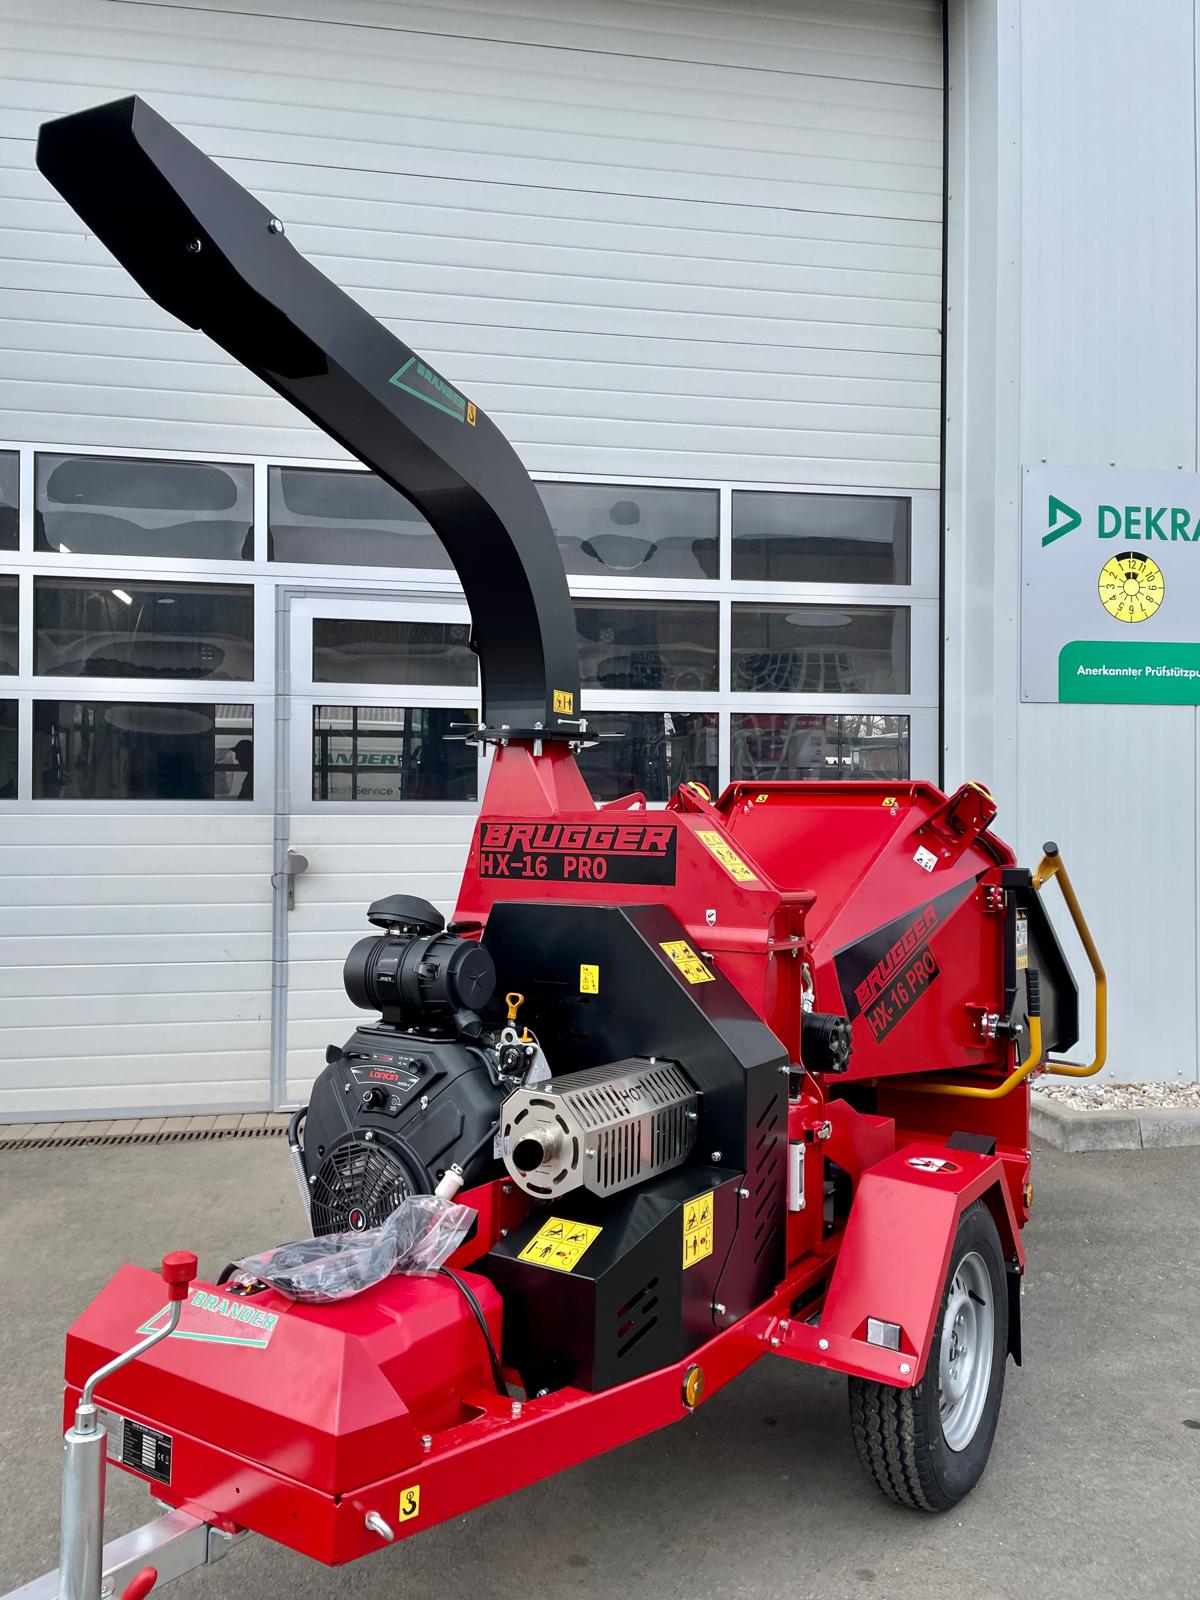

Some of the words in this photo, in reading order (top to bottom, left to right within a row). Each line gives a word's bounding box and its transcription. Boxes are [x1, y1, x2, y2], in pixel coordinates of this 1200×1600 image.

[1098, 505, 1200, 541] DEKR
[1127, 559, 1137, 570] 12
[1138, 562, 1147, 573] 11
[1108, 571, 1118, 579] 2
[1145, 571, 1156, 582] 10
[1145, 595, 1154, 603] 8
[1117, 602, 1125, 611] 5
[1128, 604, 1135, 615] 6
[1139, 602, 1146, 612] 7
[1076, 664, 1143, 676] Anerkannter
[482, 824, 675, 852] BRUGGER
[480, 853, 548, 878] HX-16
[563, 856, 608, 880] PRO
[854, 903, 938, 1007] BRUGGER
[867, 982, 910, 1038] HX-16
[905, 950, 937, 994] PRO
[619, 1085, 647, 1103] HOT
[191, 1291, 278, 1331] BRANDER
